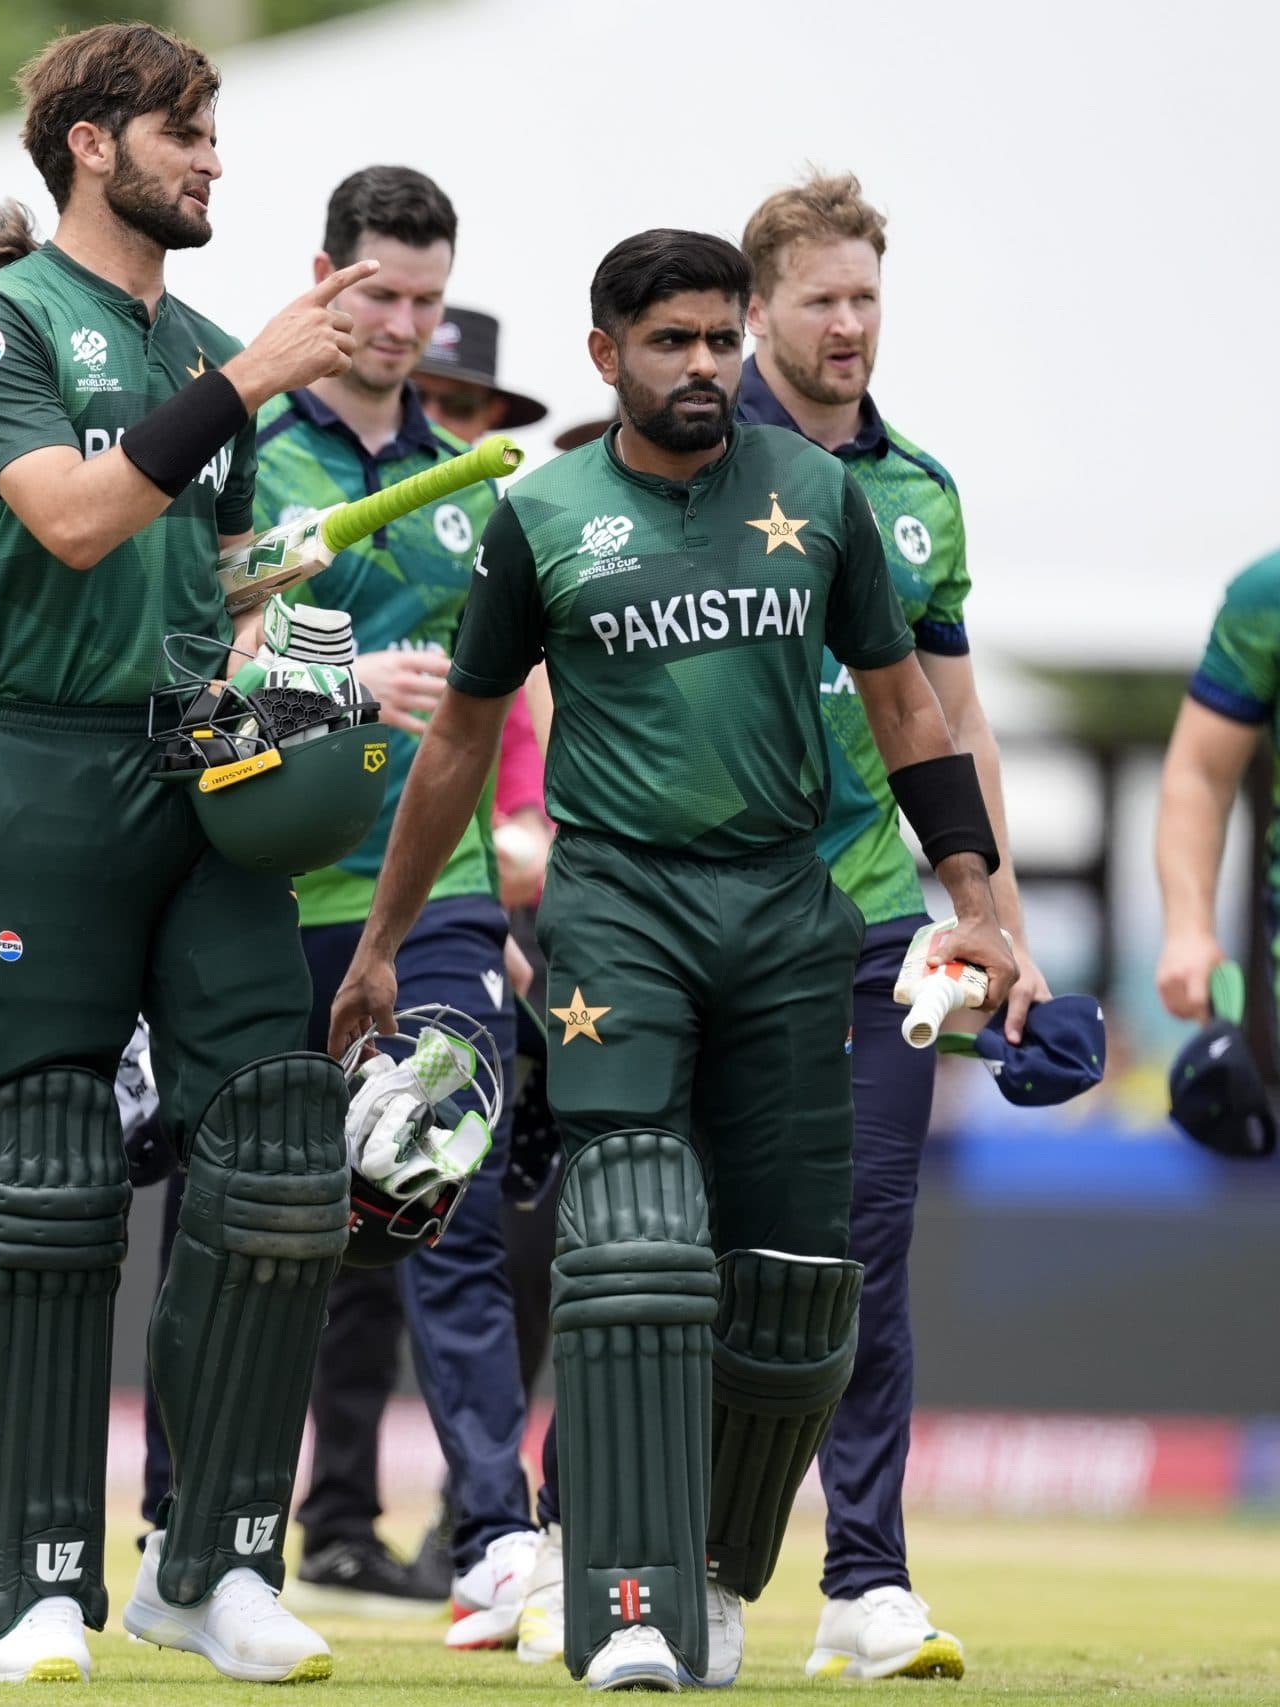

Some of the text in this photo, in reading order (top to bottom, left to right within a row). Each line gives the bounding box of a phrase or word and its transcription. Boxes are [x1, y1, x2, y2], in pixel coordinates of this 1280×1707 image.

[579, 557, 638, 577] WORLD CUP
[590, 588, 811, 655] PAKISTAN
[212, 765, 253, 785] MASURI
[234, 1514, 280, 1555] UZ
[36, 1540, 85, 1583] UZ
